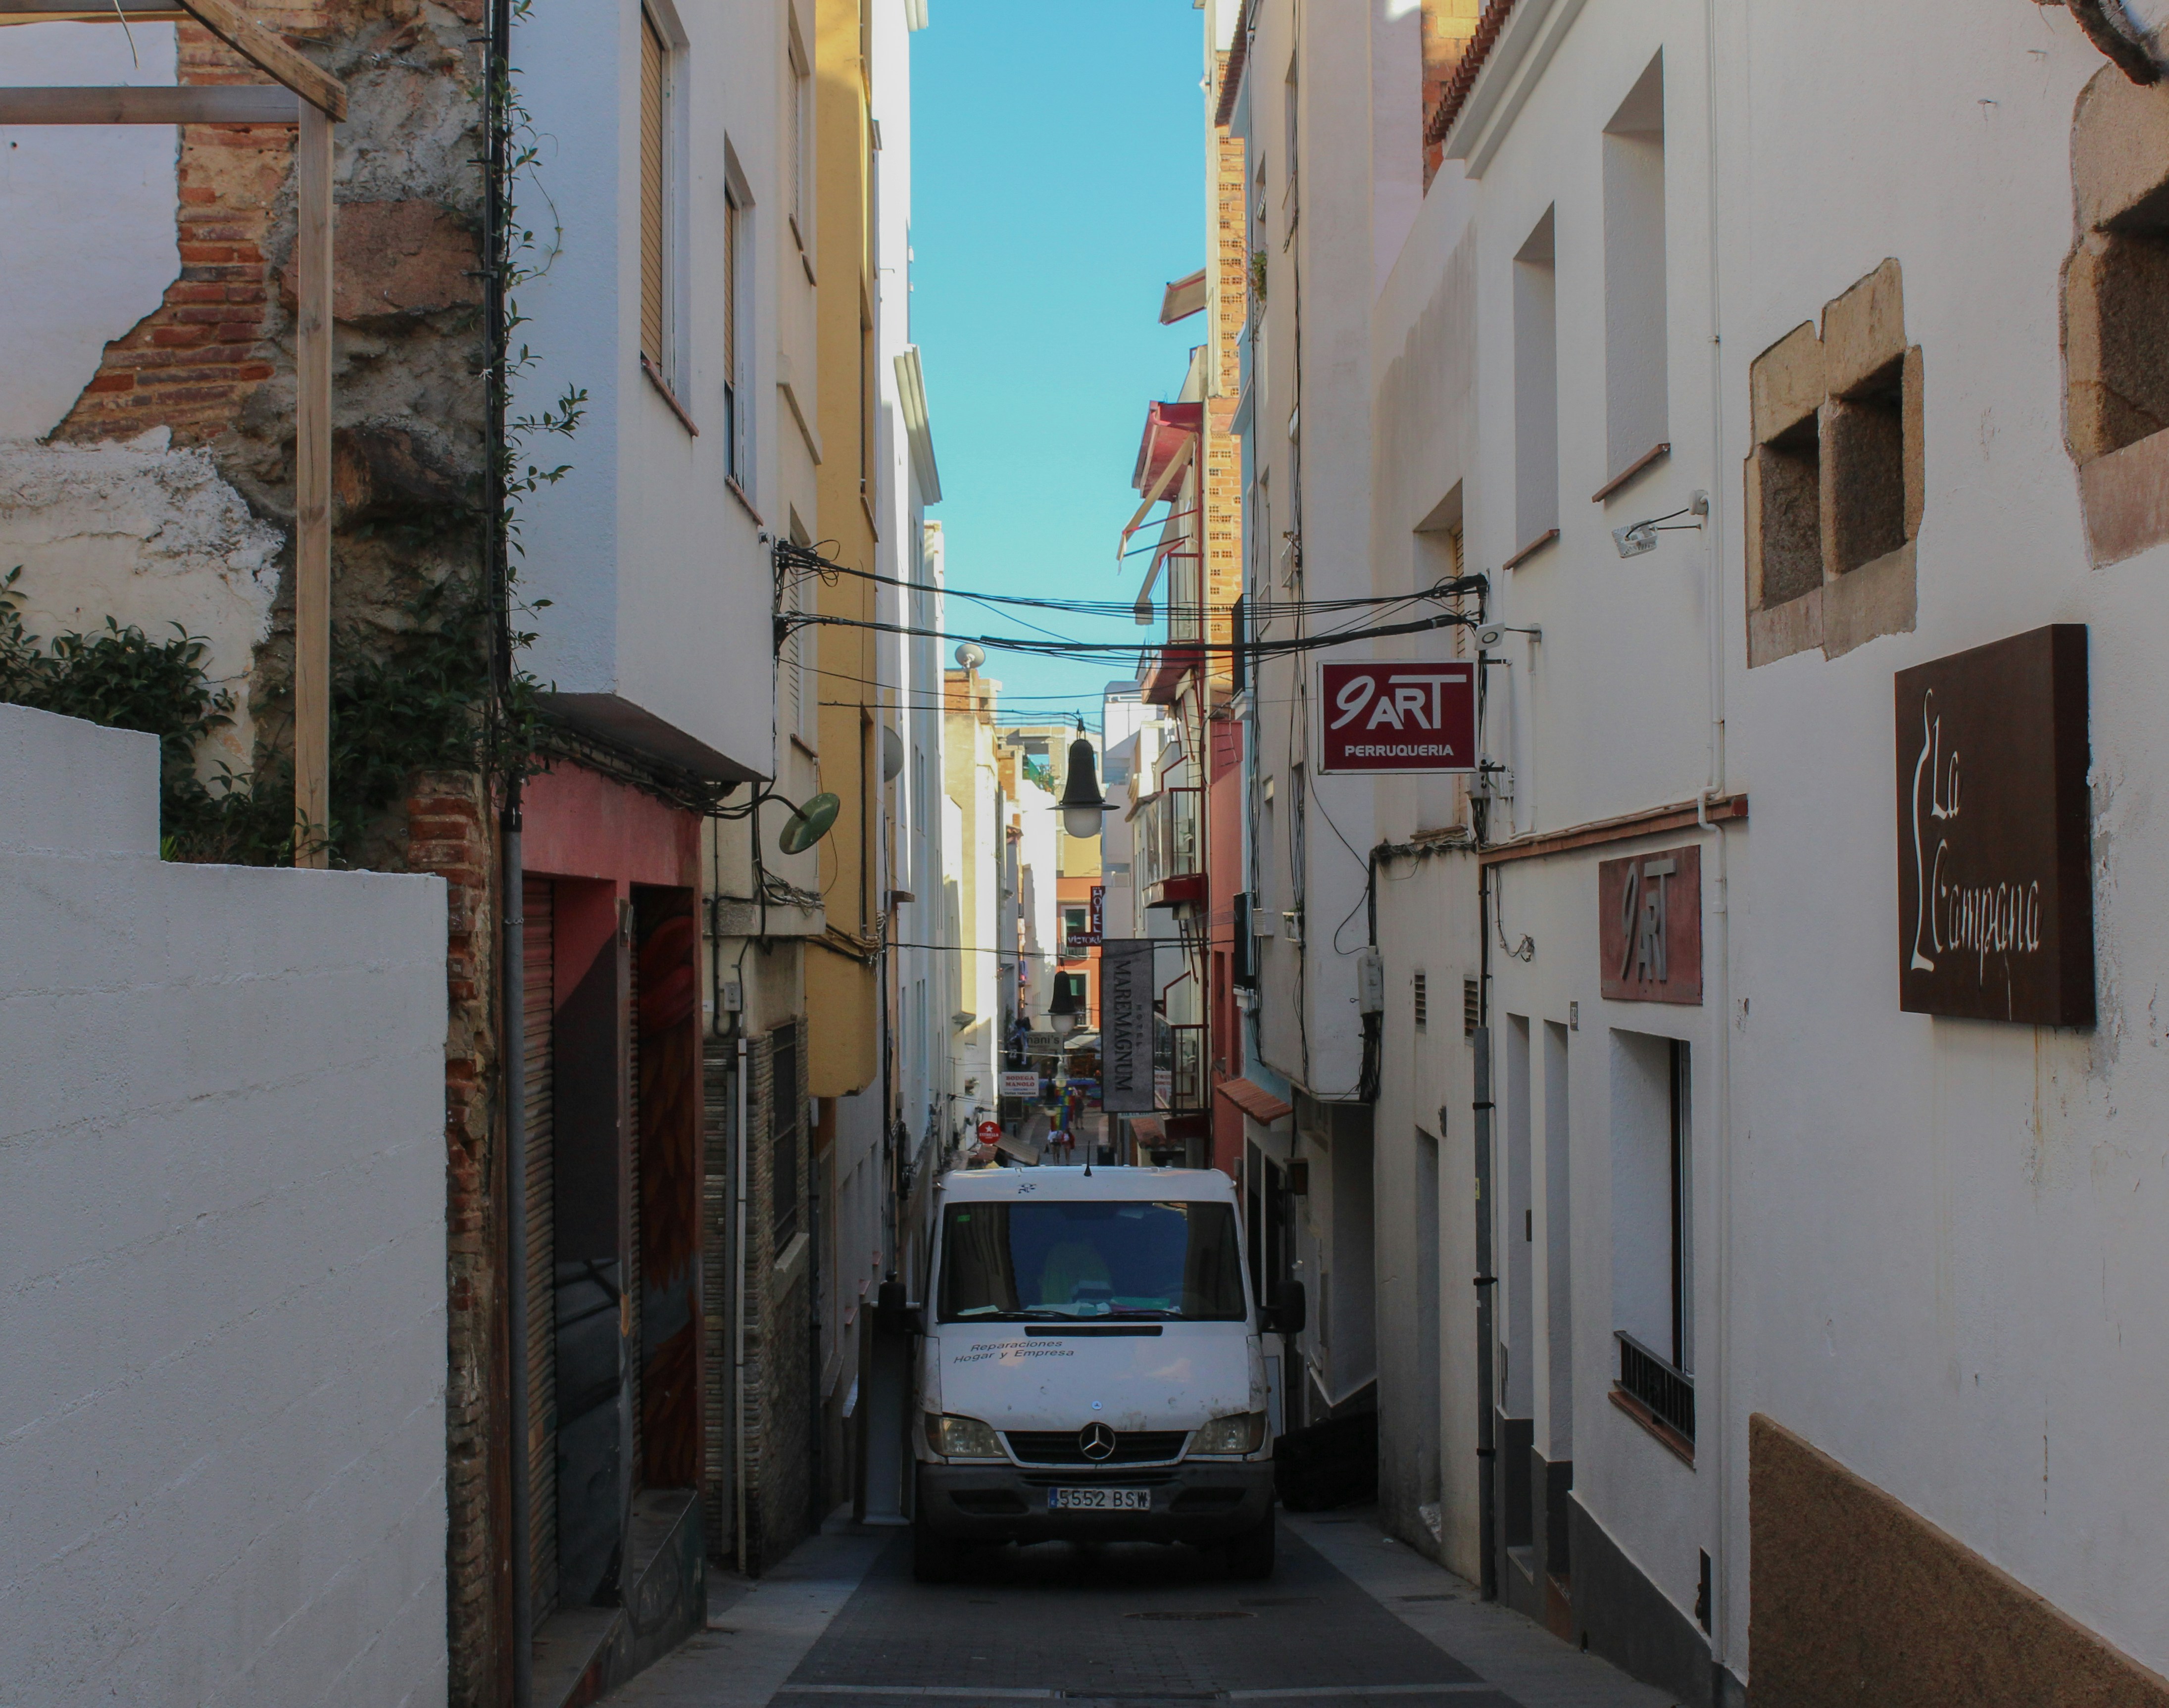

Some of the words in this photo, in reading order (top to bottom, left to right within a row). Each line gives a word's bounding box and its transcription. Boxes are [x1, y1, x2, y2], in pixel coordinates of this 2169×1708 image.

[1344, 744, 1454, 757] PERRUQUERIA
[1930, 714, 1961, 820] La
[1093, 889, 1102, 932] HOTEL
[1931, 838, 2043, 986] Campana
[1114, 961, 1133, 1092] MAREMAGNUM
[953, 1352, 995, 1364] Hogar
[1014, 1350, 1075, 1359] Empresa
[970, 1340, 1063, 1352] Reparaciones
[1060, 1490, 1106, 1507] 5552
[1113, 1491, 1147, 1508] BSW
